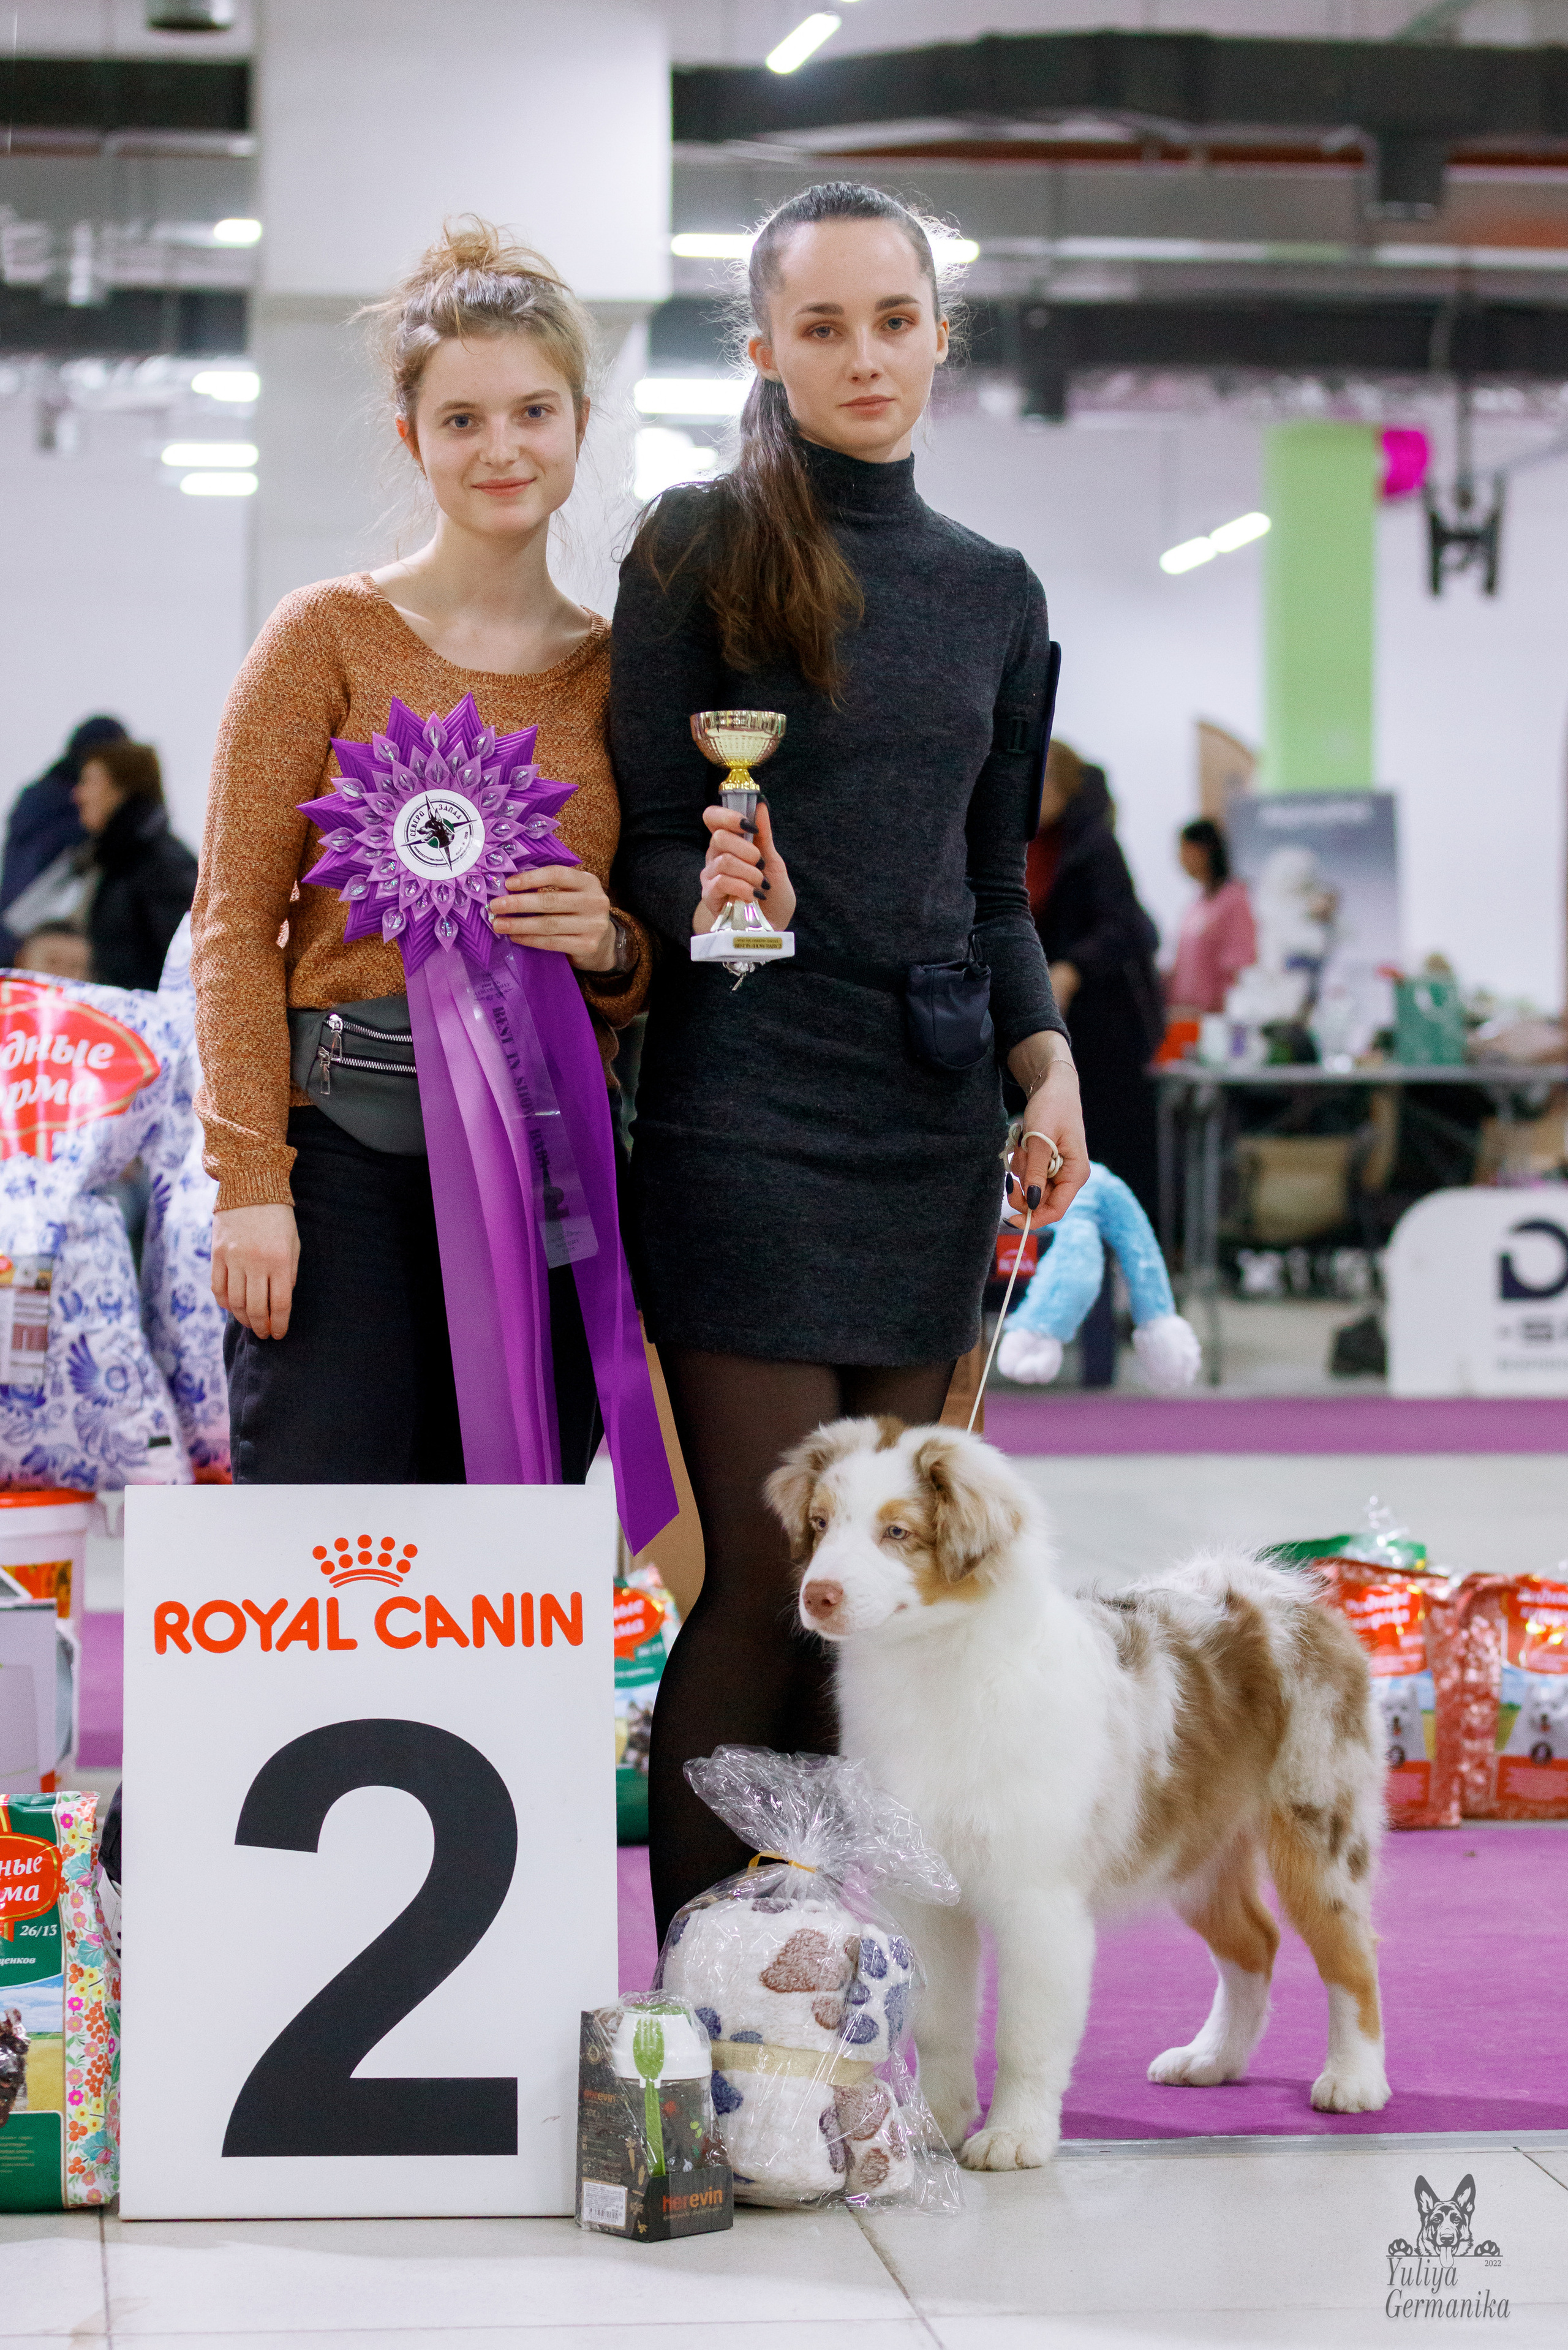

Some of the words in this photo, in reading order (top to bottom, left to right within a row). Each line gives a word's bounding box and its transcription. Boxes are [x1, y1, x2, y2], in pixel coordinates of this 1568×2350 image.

[410, 811, 424, 837] СЕВЕРО
[439, 804, 462, 819] ЗАПАД
[492, 1006, 514, 1044] BEST
[507, 1052, 521, 1070] IN
[514, 1076, 535, 1120] SHOW
[154, 1596, 358, 1655] ROYAL
[374, 1591, 583, 1649] CANIN
[20, 1924, 58, 1938] 26/13
[221, 1718, 518, 2158] 2
[662, 2186, 723, 2213] herevin
